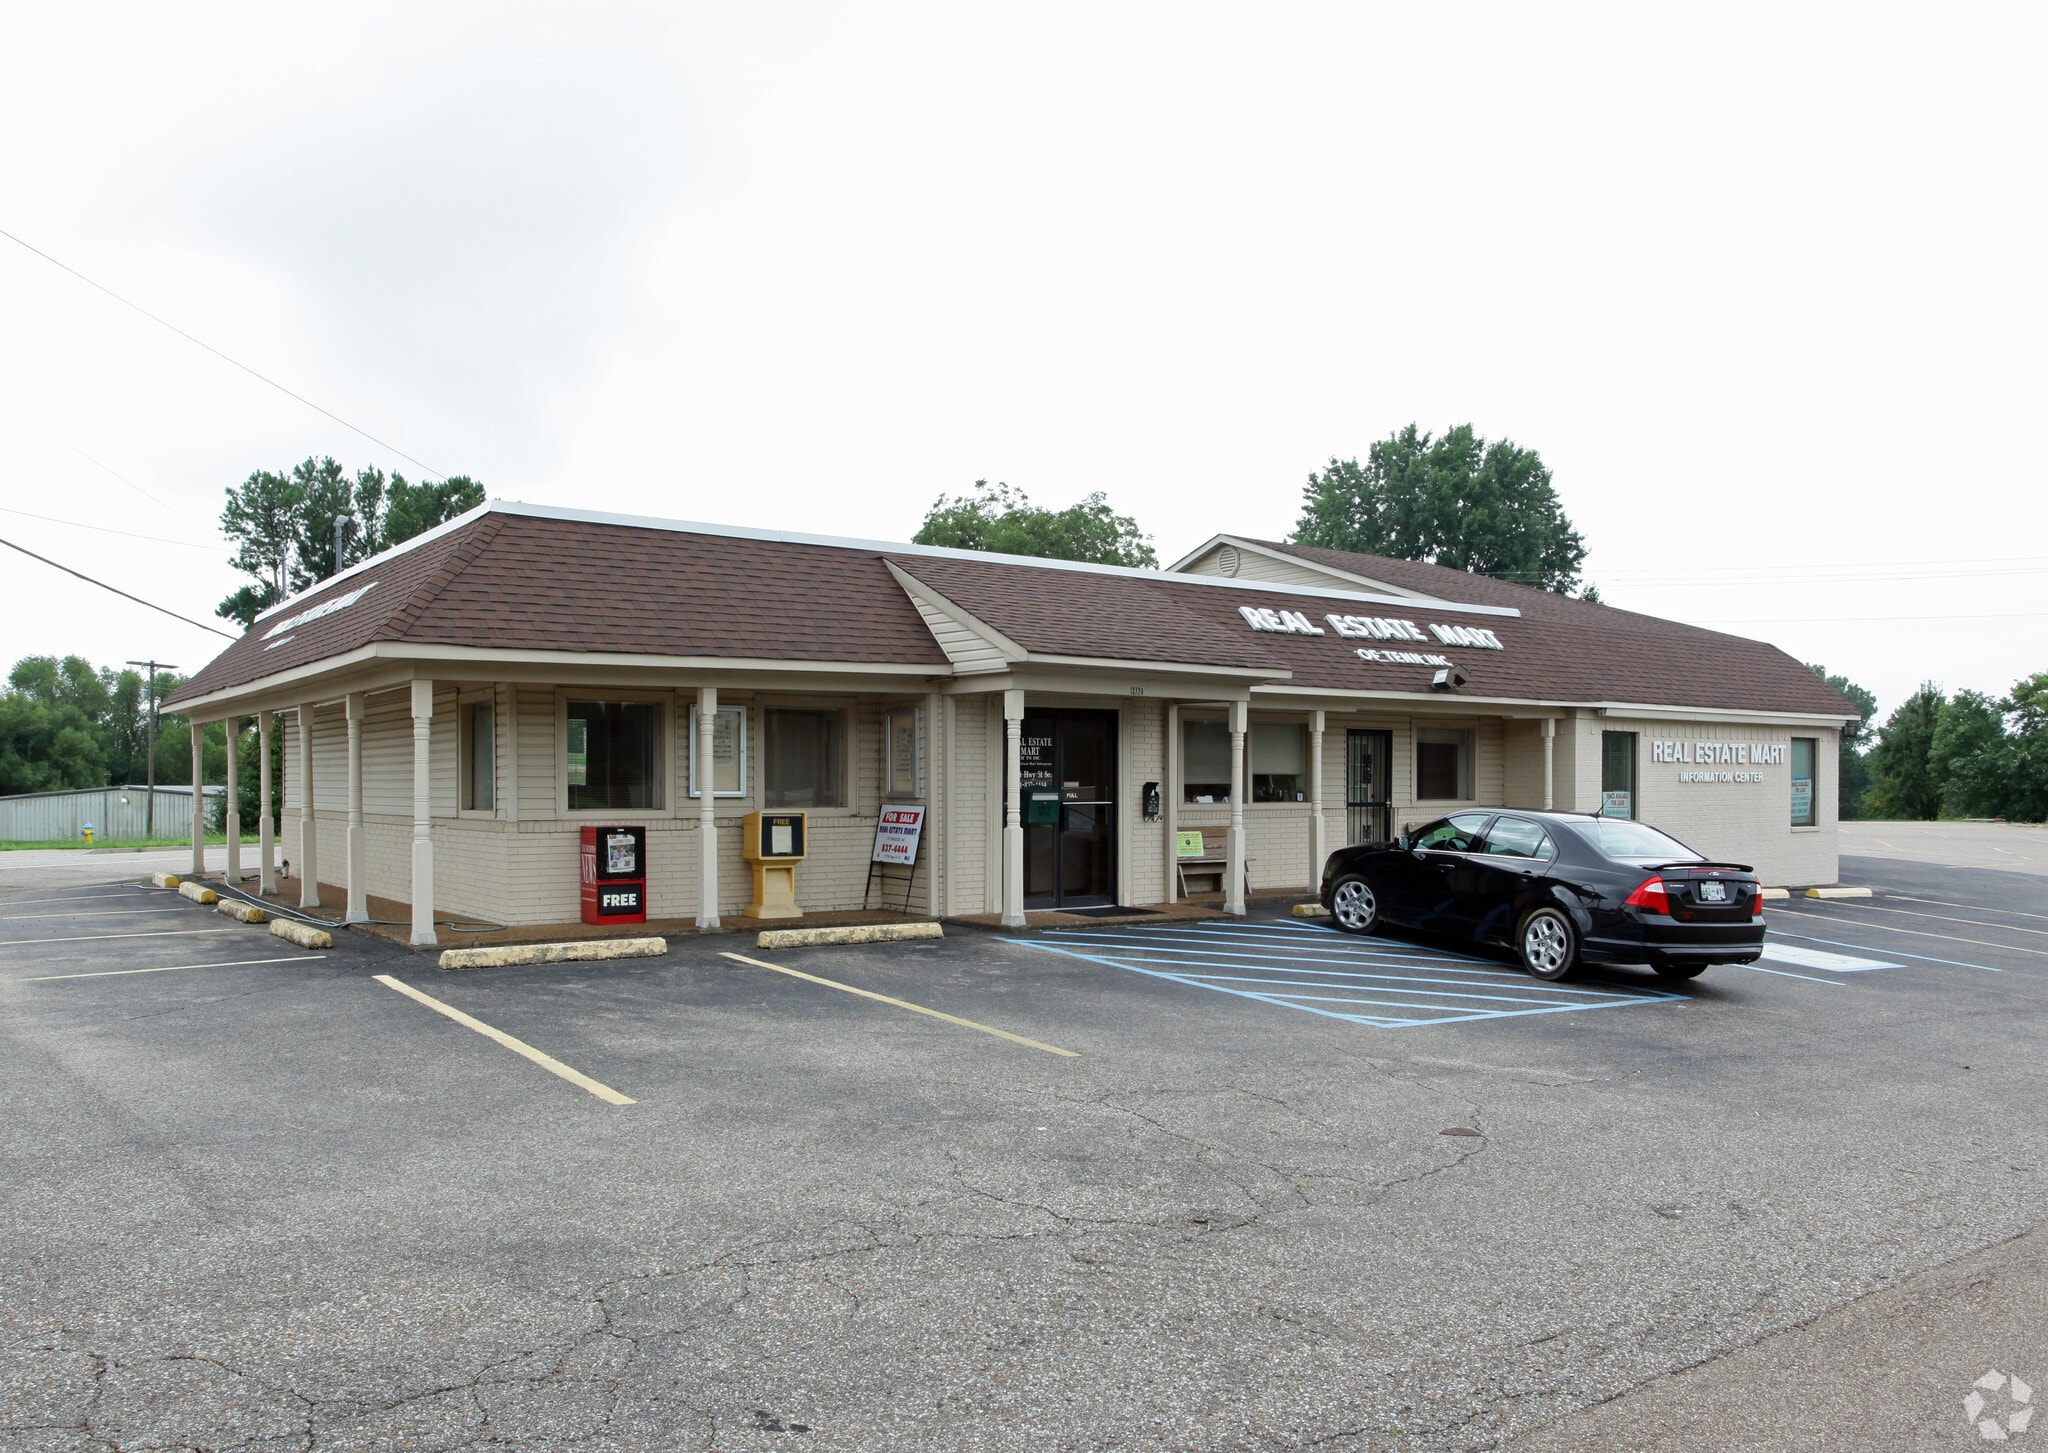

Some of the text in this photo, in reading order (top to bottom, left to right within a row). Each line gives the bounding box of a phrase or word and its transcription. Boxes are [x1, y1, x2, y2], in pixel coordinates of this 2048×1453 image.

[1238, 606, 1504, 651] REAL ESTATE MART
[1356, 648, 1380, 661] OF
[1028, 737, 1052, 746] ESTATE
[1020, 746, 1040, 755] MART
[1652, 740, 1786, 764] REAL ESTATE MART
[1023, 770, 1035, 780] Hwy
[1680, 771, 1764, 783] INFORMATION CENTER
[885, 813, 914, 823] FOR SALE
[903, 827, 917, 835] MART
[603, 893, 637, 907] FREE
